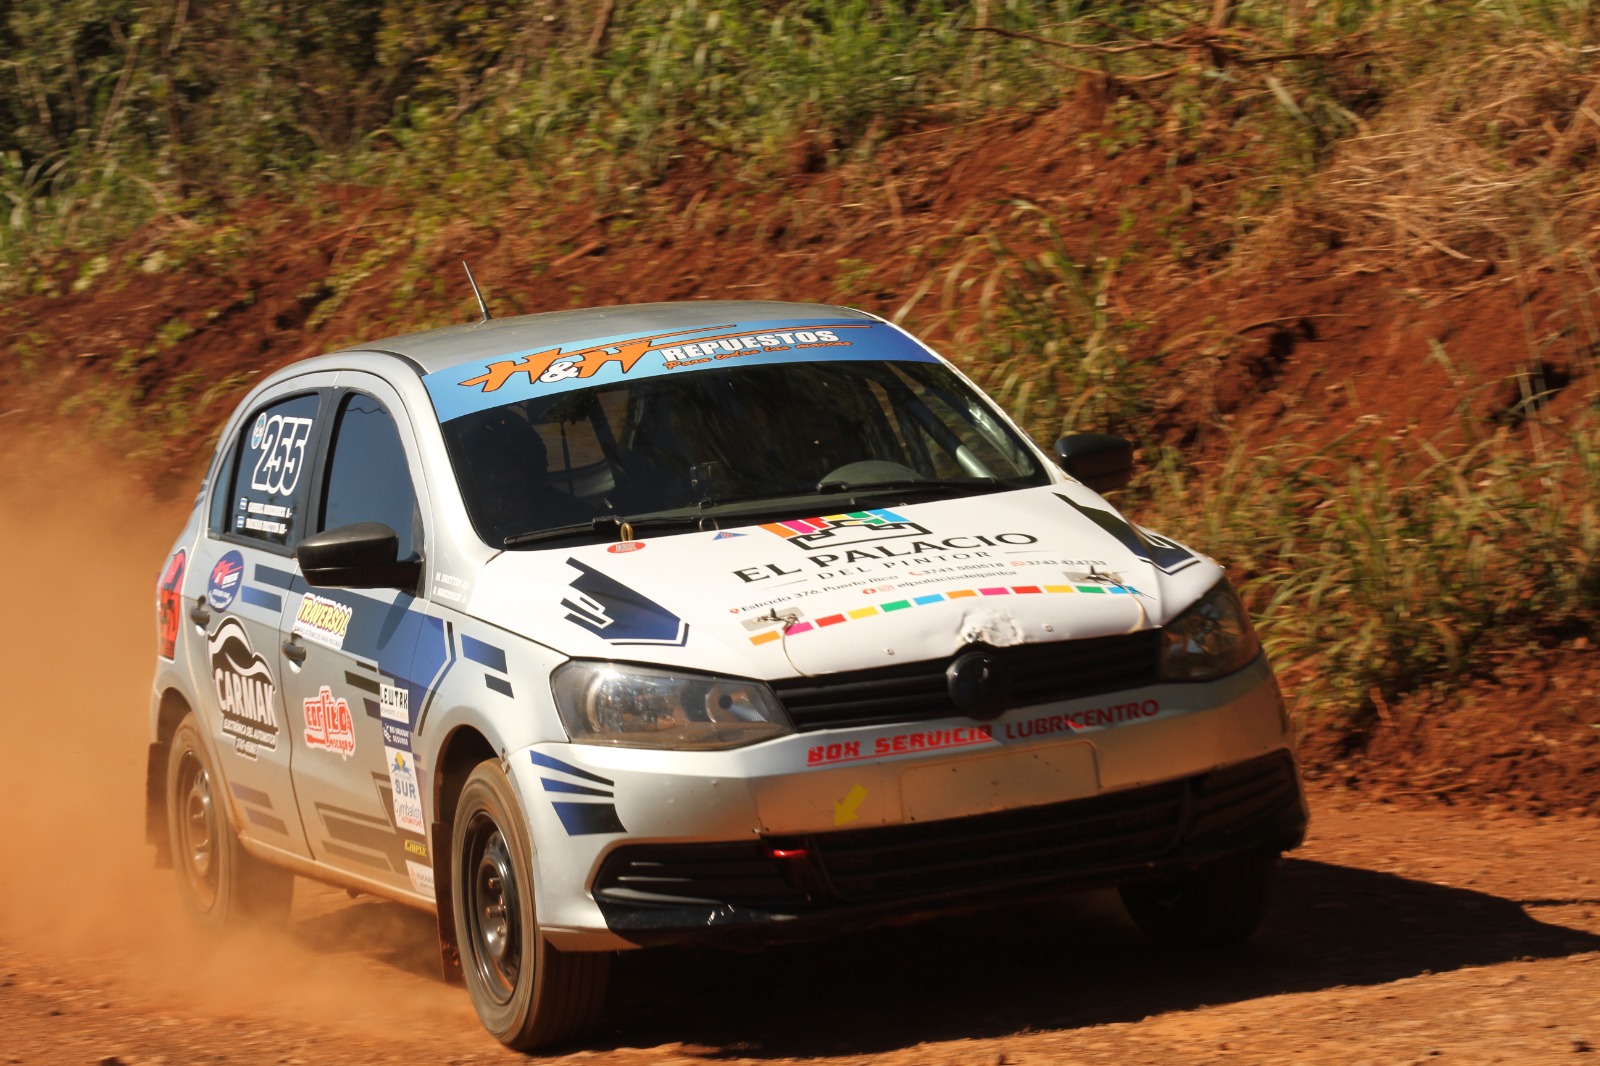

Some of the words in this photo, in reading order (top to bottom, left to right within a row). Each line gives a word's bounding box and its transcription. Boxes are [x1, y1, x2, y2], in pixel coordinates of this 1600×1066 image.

[661, 330, 840, 363] REPUESTOS
[250, 414, 313, 496] 255
[732, 563, 802, 583] EL
[807, 533, 1038, 568] PALACIO
[817, 566, 872, 580] DEL
[882, 550, 992, 569] PINTOR
[741, 595, 791, 612] Estrada
[823, 579, 866, 592] Puerto
[867, 574, 899, 584] Rico
[297, 596, 352, 638] TRAVERSOL
[214, 668, 279, 728] CARMAK
[807, 740, 861, 763] BOX
[874, 724, 993, 754] SERVICIO
[1005, 699, 1160, 740] LUBRICENTRO
[395, 778, 417, 799] SUR
